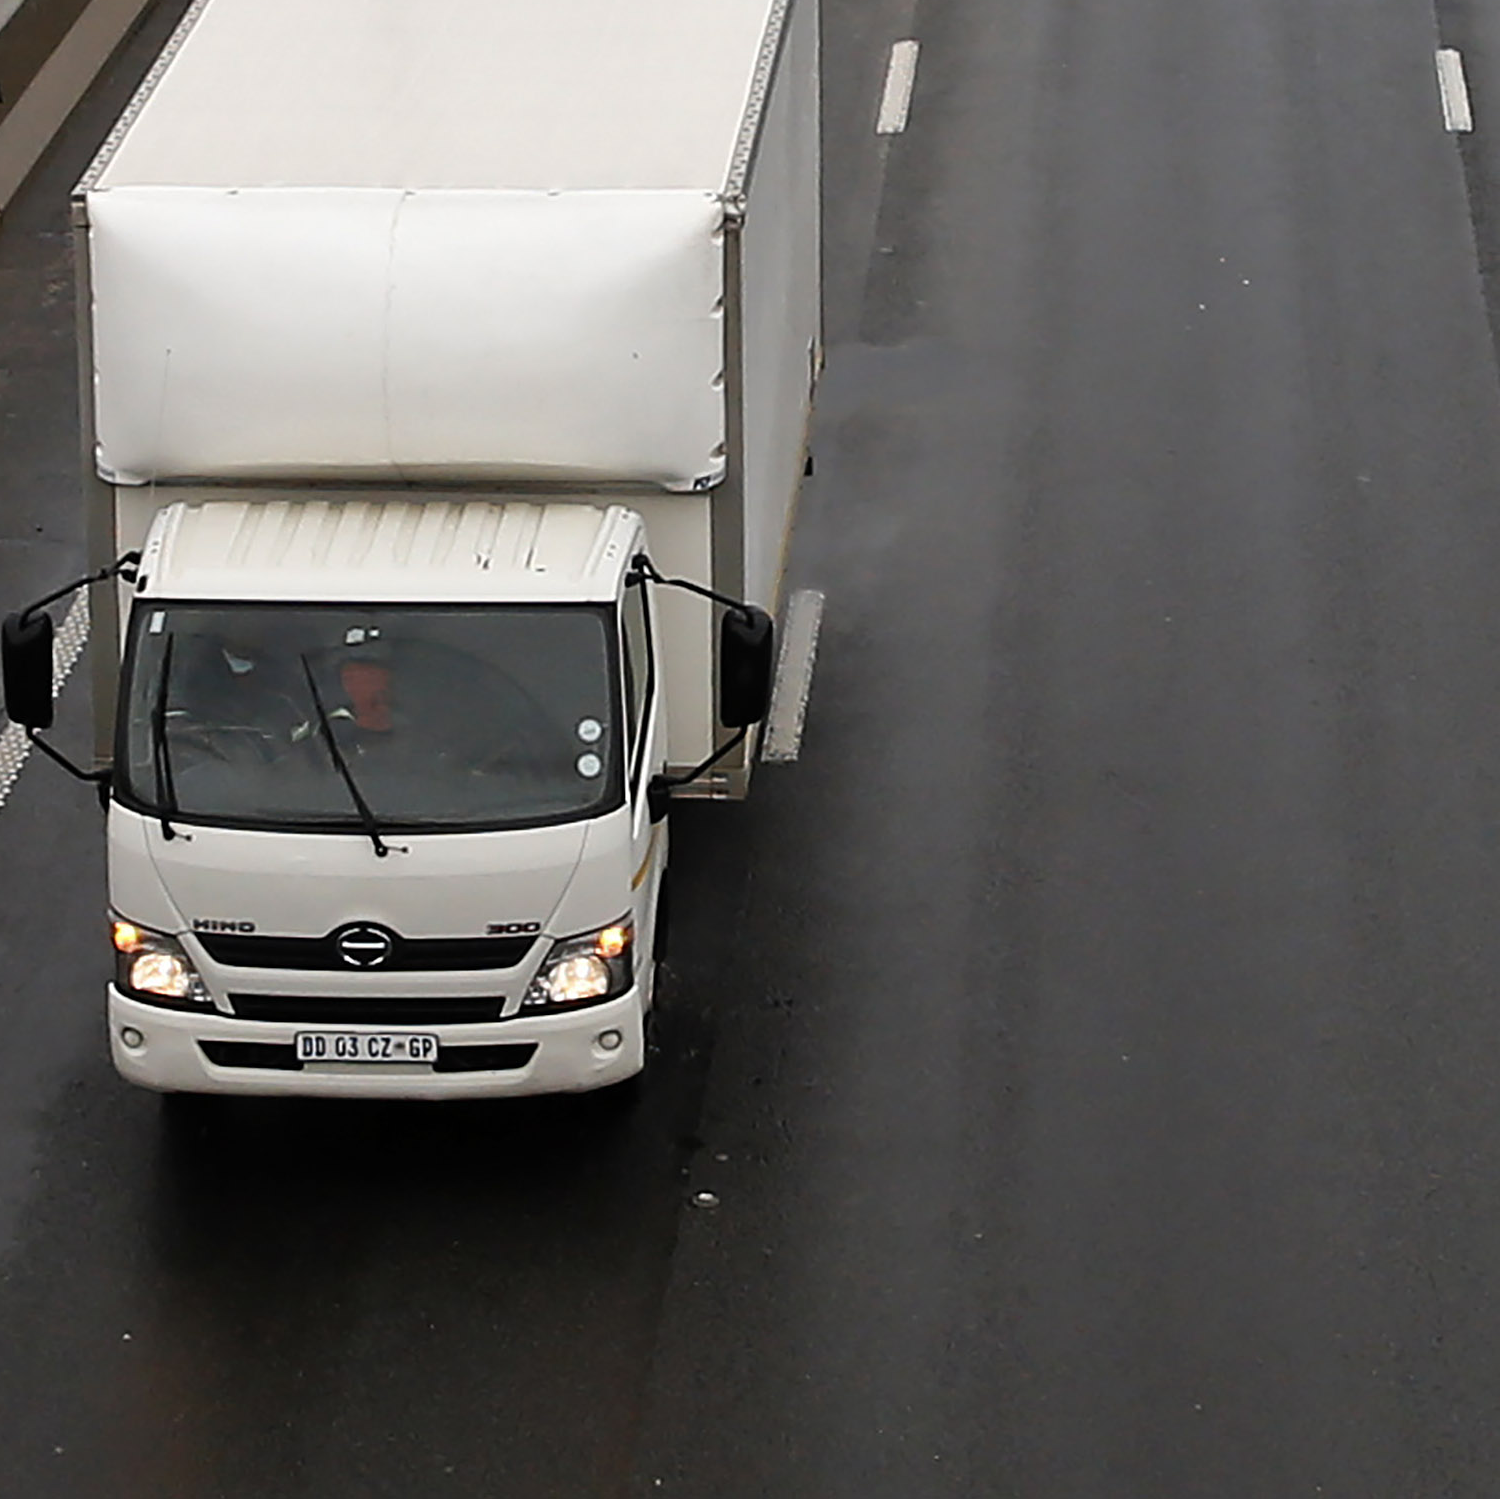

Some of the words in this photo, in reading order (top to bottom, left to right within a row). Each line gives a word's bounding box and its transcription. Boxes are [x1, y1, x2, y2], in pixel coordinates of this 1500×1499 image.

[192, 918, 256, 933] HINO
[486, 921, 541, 935] 300
[302, 1036, 326, 1057] DD
[335, 1036, 358, 1058] 03
